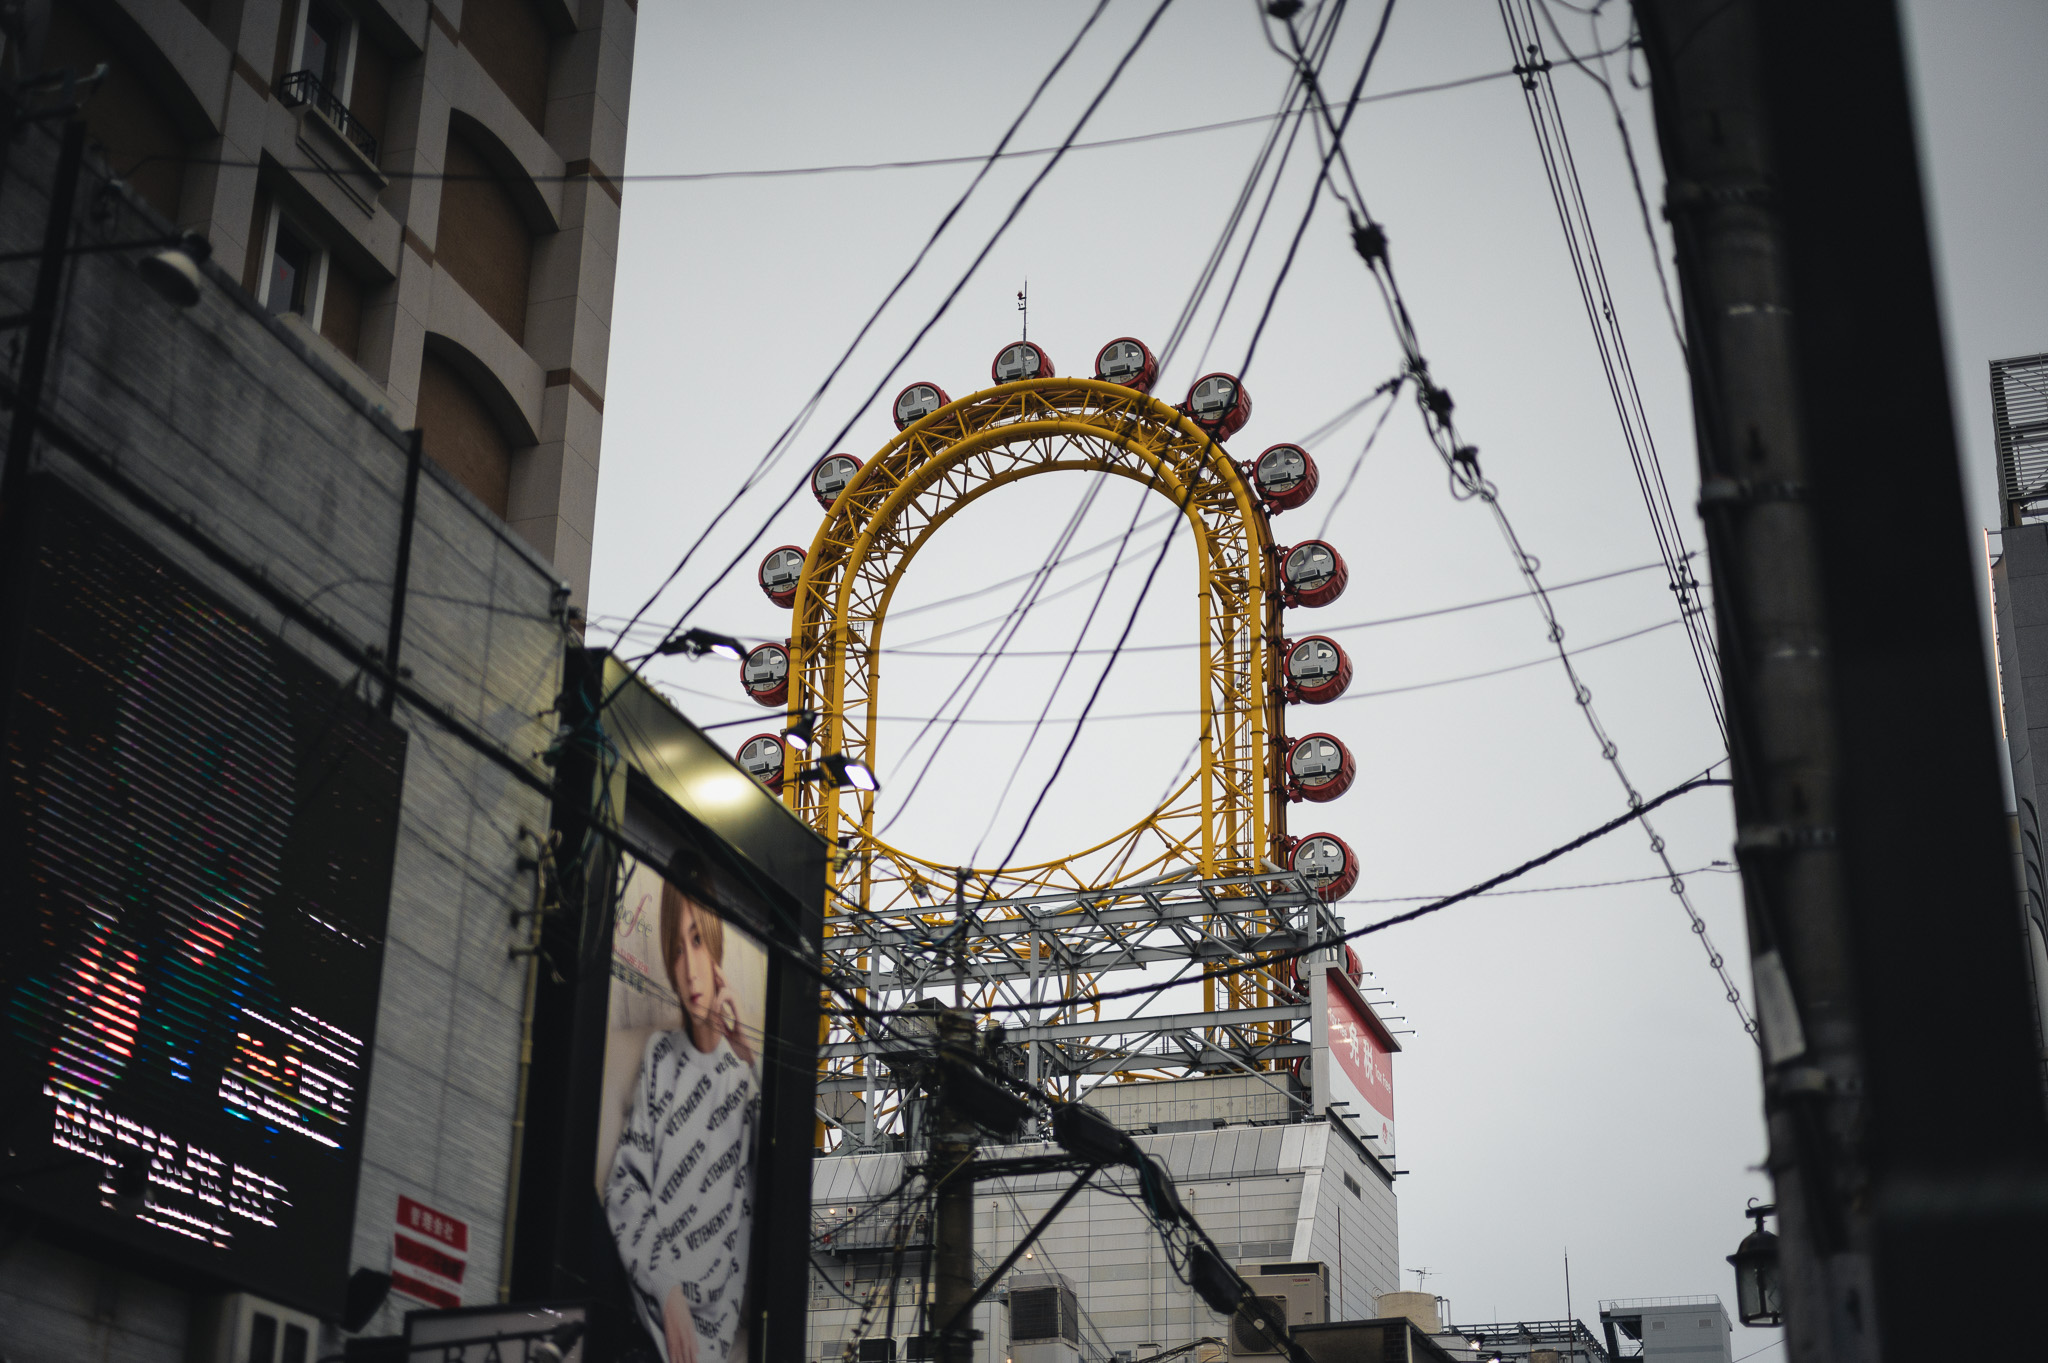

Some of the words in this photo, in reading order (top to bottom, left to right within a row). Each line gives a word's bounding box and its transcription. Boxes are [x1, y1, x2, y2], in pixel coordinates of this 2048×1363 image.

[1349, 1021, 1374, 1085] 免税
[1382, 1072, 1392, 1094] Free
[665, 1074, 712, 1137] VETEMENTS
[707, 1079, 749, 1132] VETEMENTS
[658, 1139, 706, 1205] VETEMENTS
